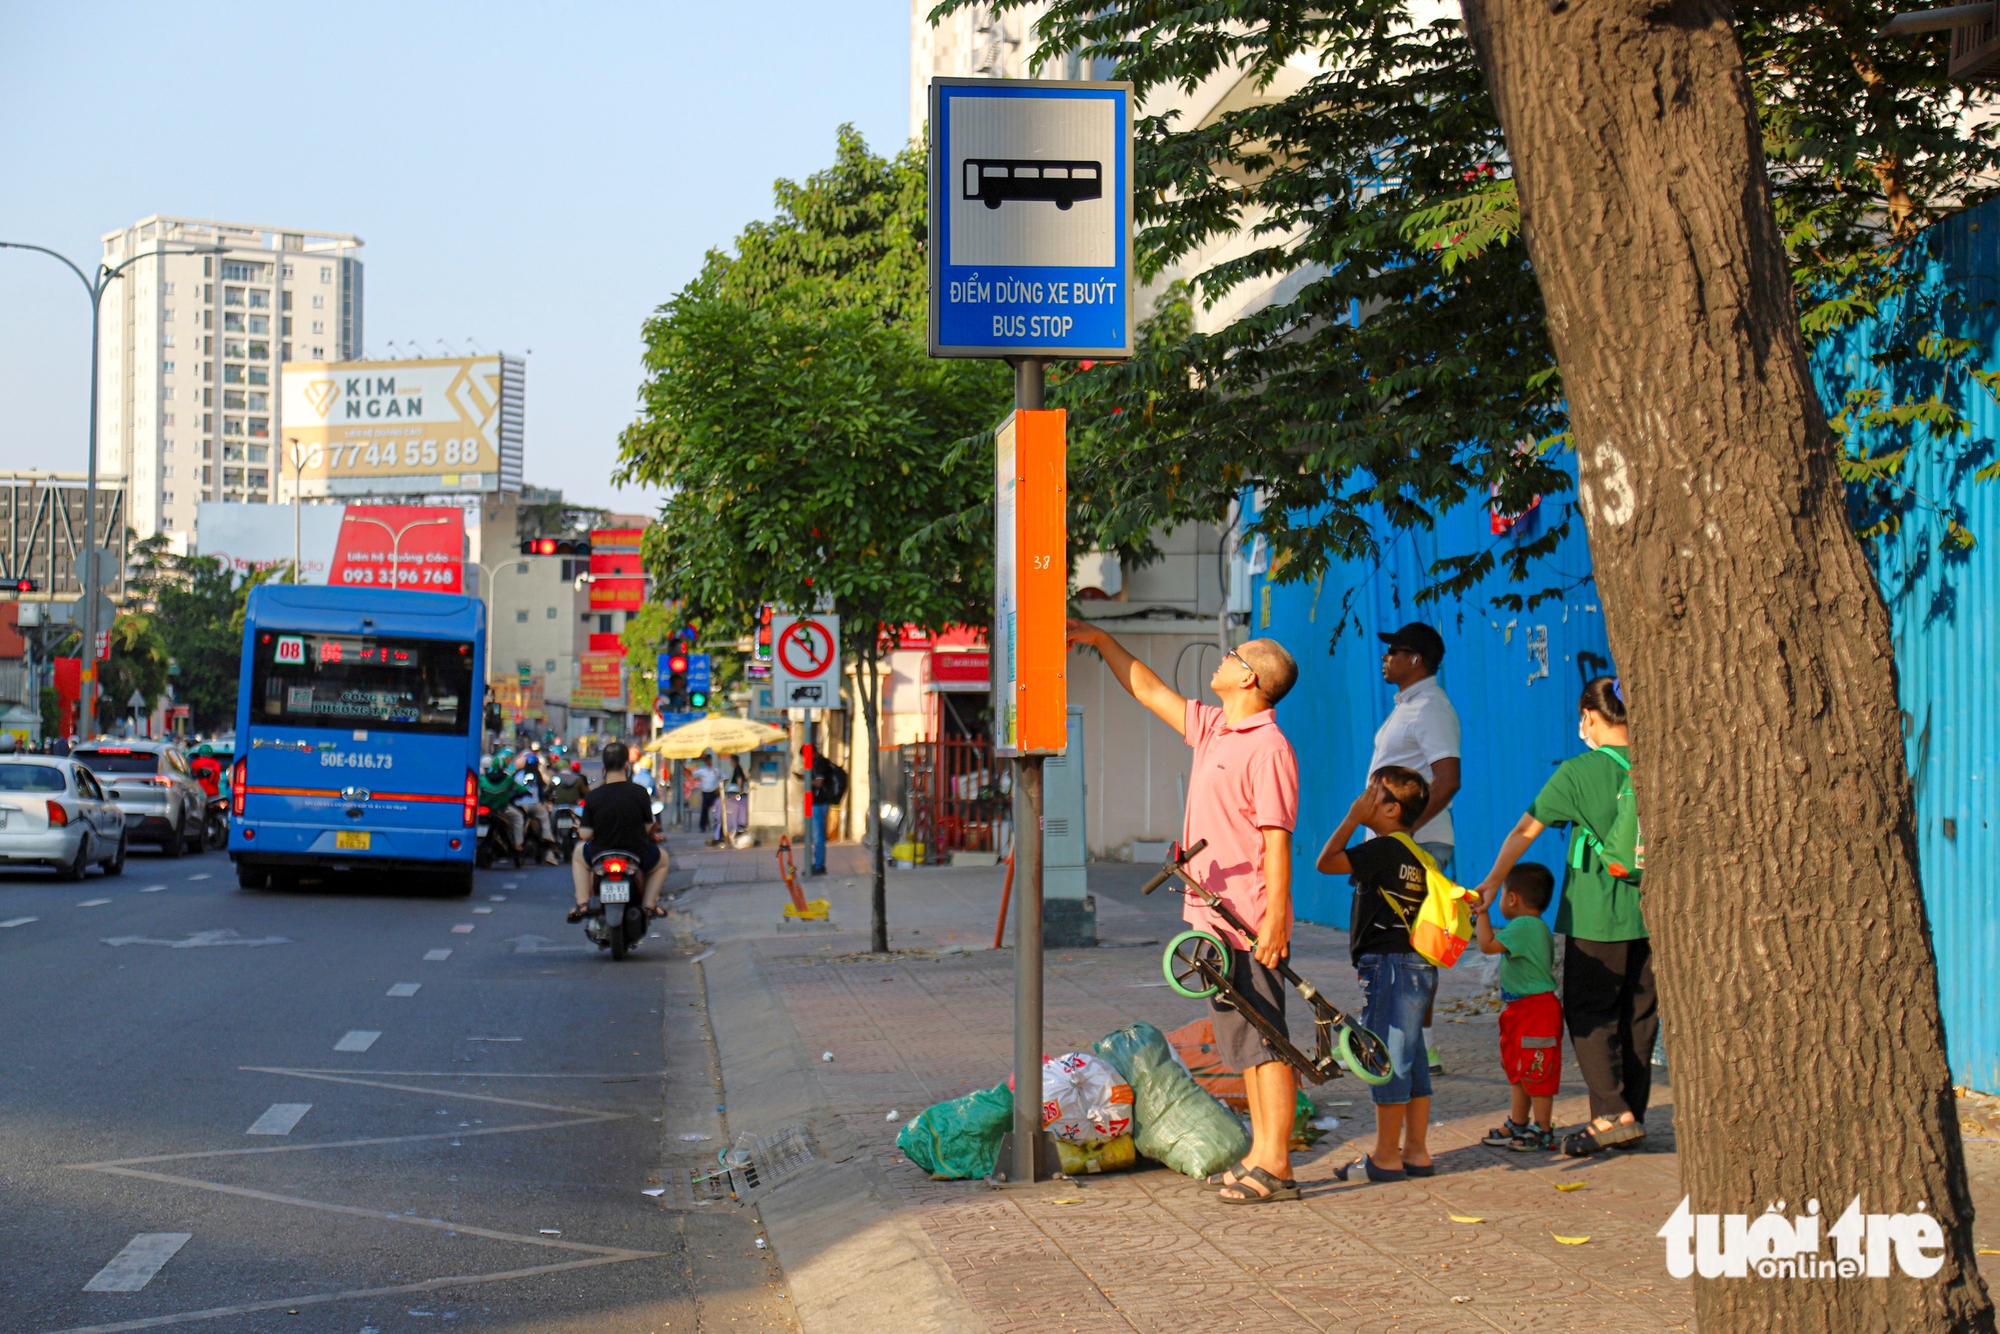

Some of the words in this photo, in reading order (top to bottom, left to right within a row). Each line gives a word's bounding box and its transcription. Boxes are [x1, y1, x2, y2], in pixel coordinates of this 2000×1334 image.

[950, 272, 991, 304] ĐIỂM
[996, 276, 1043, 304] DỪNG
[1048, 282, 1069, 304] XE
[1073, 277, 1116, 305] BUÝT
[993, 316, 1026, 337] BUS
[1030, 316, 1073, 338] STOP
[346, 377, 396, 397] KIM
[346, 398, 423, 419] NGAN
[235, 557, 278, 572] Taget
[1033, 555, 1051, 570] 38
[343, 567, 374, 584] 093
[423, 568, 453, 585] 768
[280, 642, 300, 660] 08
[321, 752, 393, 769] 50E-616.73
